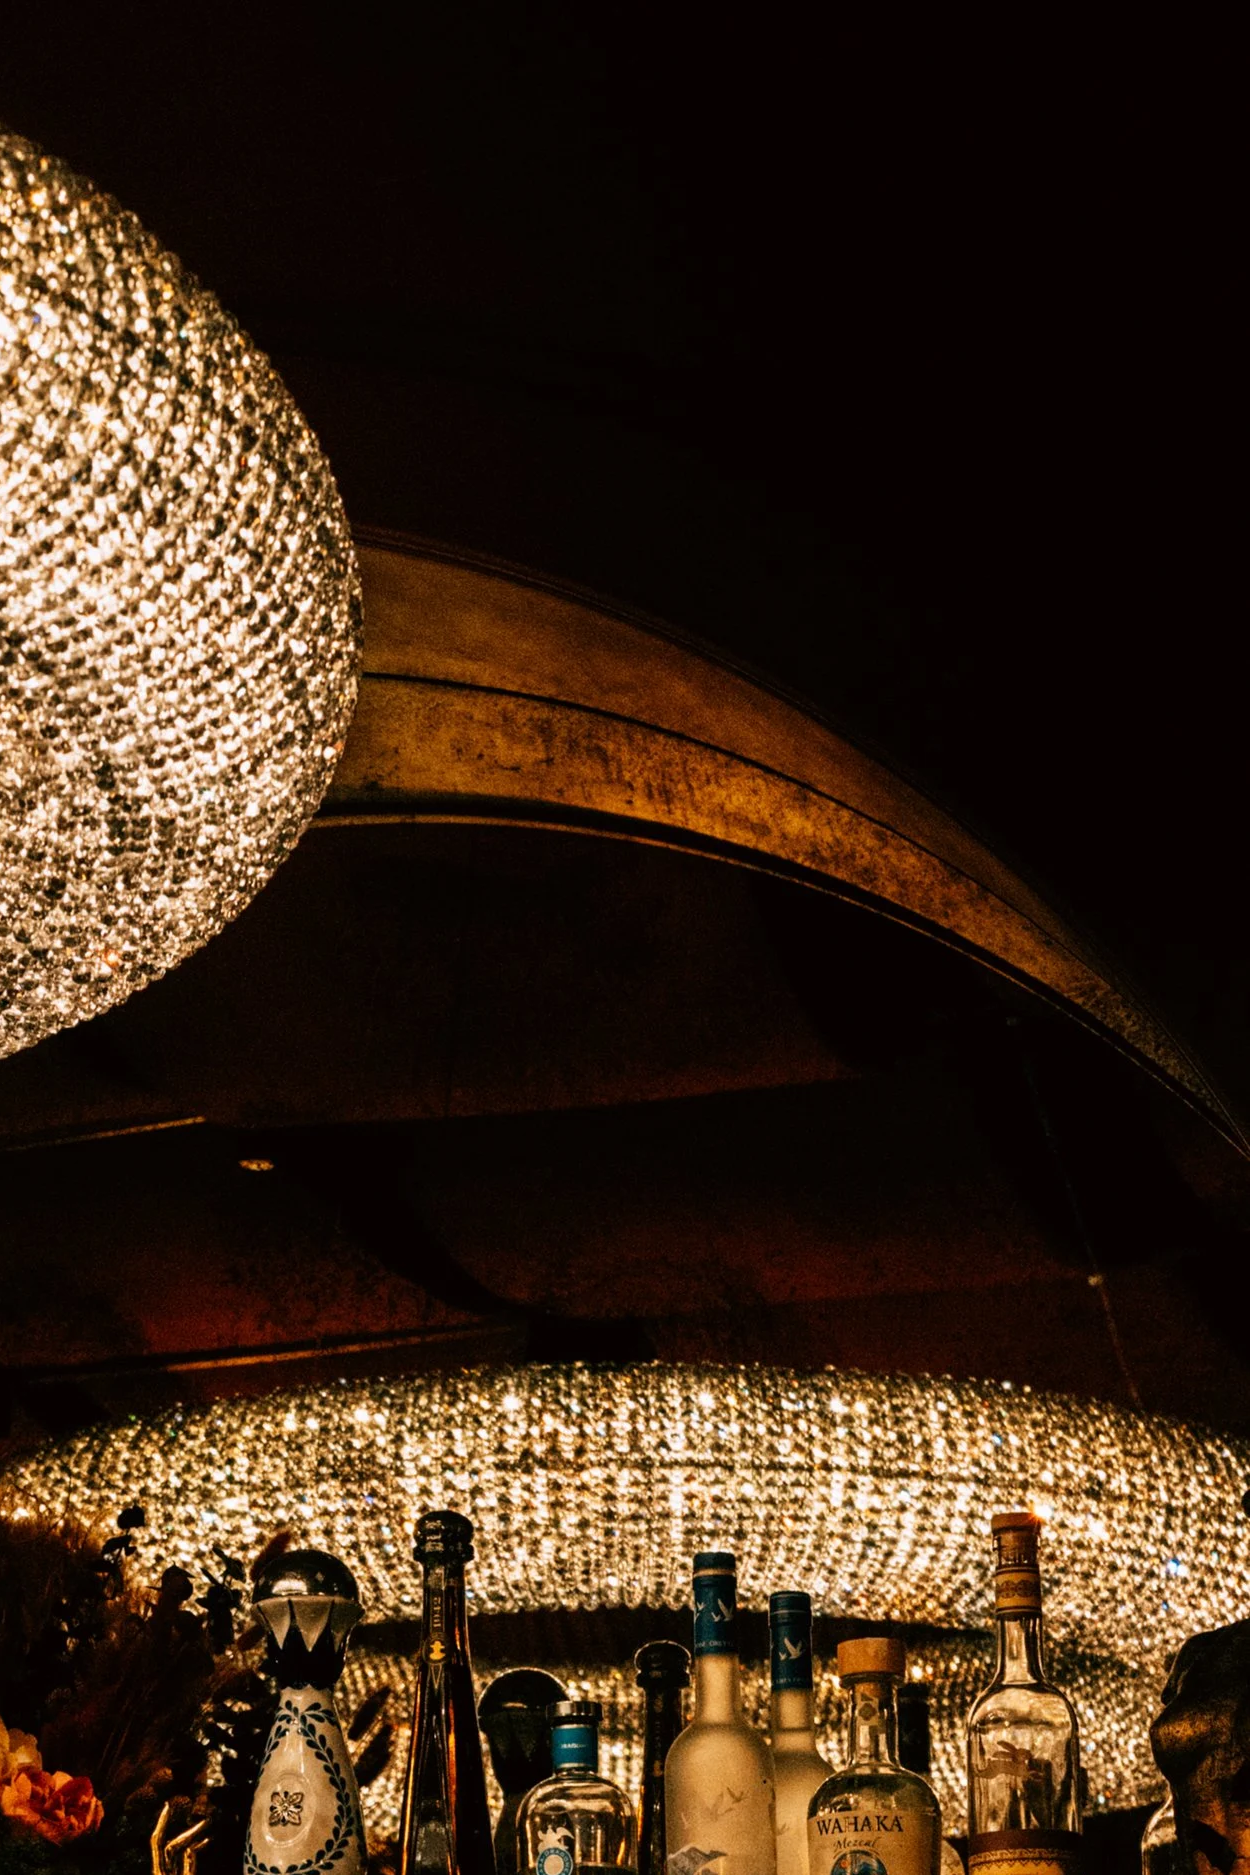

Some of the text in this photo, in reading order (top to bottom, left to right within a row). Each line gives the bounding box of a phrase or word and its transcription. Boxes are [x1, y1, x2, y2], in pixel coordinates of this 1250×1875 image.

[432, 1596, 442, 1628] 1942
[817, 1815, 903, 1835] WAHAKA
[834, 1837, 880, 1850] Mezcal
